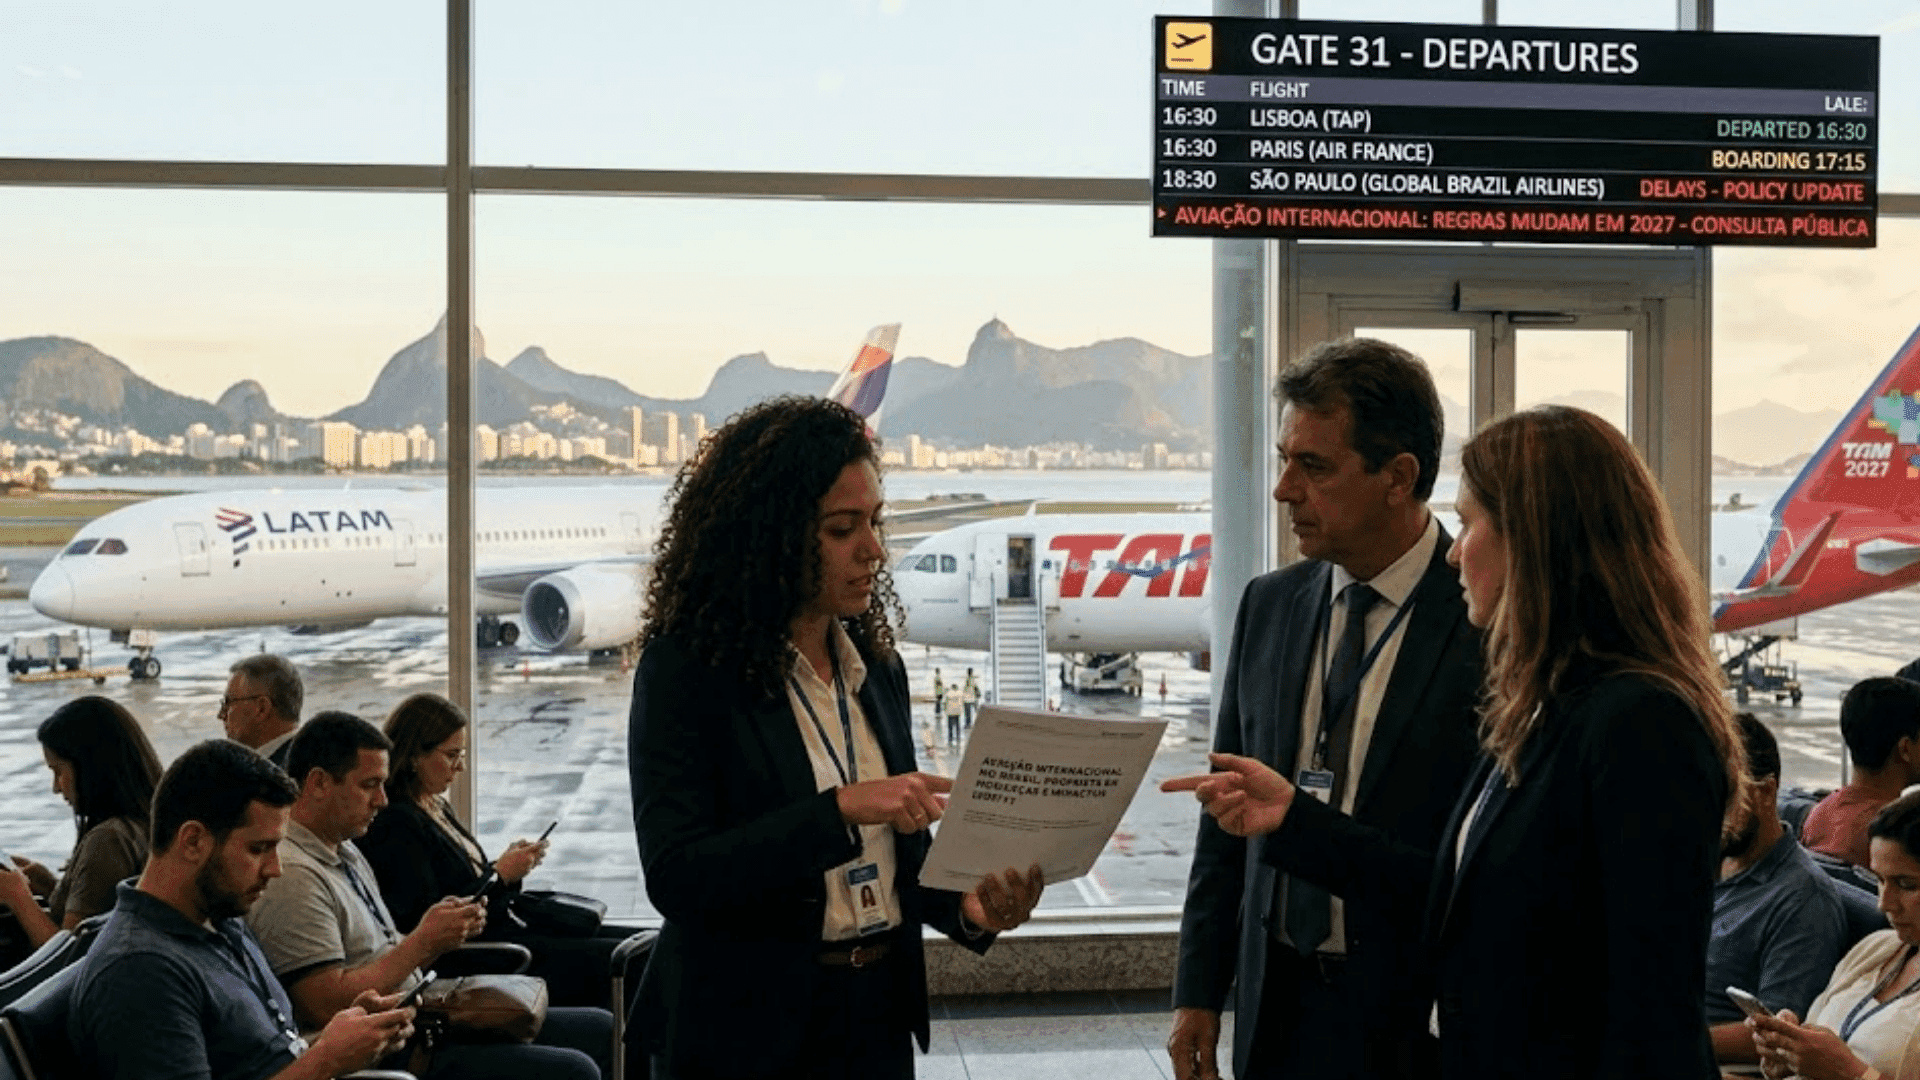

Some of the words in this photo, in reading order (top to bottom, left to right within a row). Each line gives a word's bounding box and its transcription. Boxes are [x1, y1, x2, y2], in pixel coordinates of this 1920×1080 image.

[1251, 32, 1339, 66] GATE
[1350, 36, 1391, 68] 31
[1400, 51, 1414, 59] -
[1423, 37, 1639, 74] DEPARTURES
[1162, 79, 1206, 96] TIME
[1250, 82, 1309, 98] FLIGHT
[1163, 107, 1217, 126] 16:30
[1250, 109, 1318, 129] LISBOA
[1323, 109, 1372, 133] (TAP)
[1717, 119, 1811, 138] DEPARTED
[1816, 122, 1867, 140] 16:30
[1163, 138, 1217, 157] 16:30
[1250, 140, 1304, 159] PARIS
[1309, 140, 1347, 163] (AIR
[1352, 141, 1434, 166] FRANCE)
[1712, 149, 1811, 170] BOARDING
[1815, 152, 1866, 171] 17:15
[1163, 169, 1217, 189] 18:30
[1250, 168, 1290, 190] SÃO
[1294, 172, 1357, 191] PAULO
[1362, 172, 1443, 196] (GLOBAL
[1447, 175, 1511, 195] BRAZIL
[1515, 176, 1605, 200] AIRLINES)
[1640, 179, 1706, 198] DELAYS
[1723, 181, 1788, 200] POLICY
[1792, 183, 1865, 201] UPDATE
[1174, 202, 1262, 229] AVIAÇÃO
[1266, 206, 1428, 228] INTERNACIONAL:
[1433, 210, 1507, 230] REGRAS
[1511, 212, 1589, 231] MUDAM
[1595, 214, 1625, 232] EM
[1629, 215, 1675, 233] 2027
[1691, 216, 1787, 235] CONSULTA
[1792, 213, 1869, 237] PÚBLICA
[1841, 441, 1894, 460] TAM
[1844, 460, 1890, 478] 2027
[262, 510, 393, 533] LATAM
